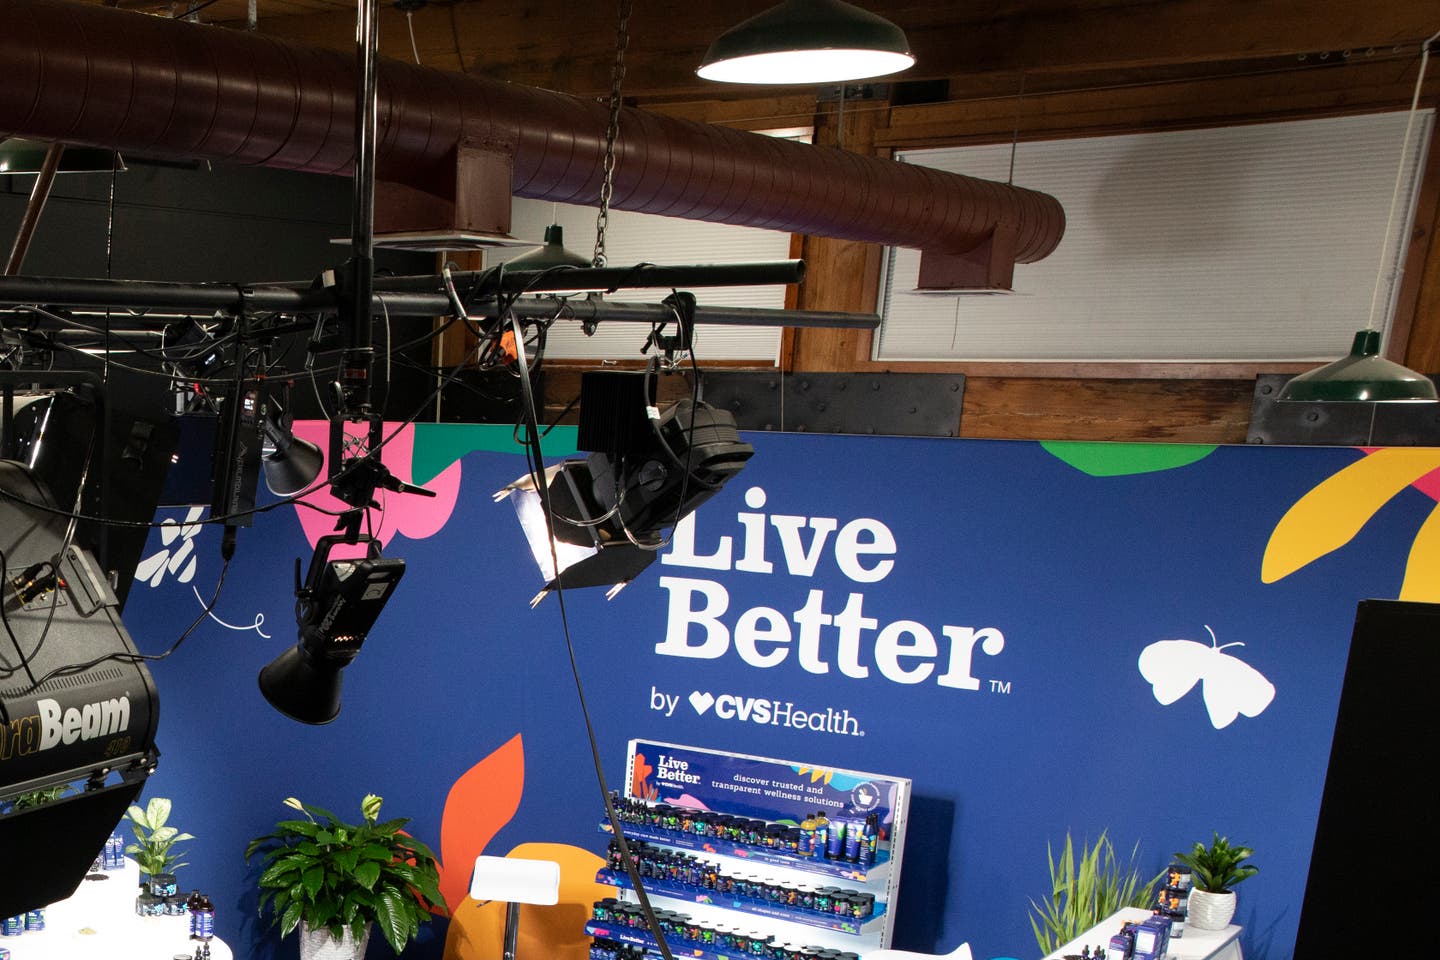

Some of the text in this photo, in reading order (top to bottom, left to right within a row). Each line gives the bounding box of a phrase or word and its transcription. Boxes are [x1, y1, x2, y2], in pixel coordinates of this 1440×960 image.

[661, 486, 897, 583] Live
[655, 575, 1006, 691] Better
[649, 685, 680, 717] by
[656, 766, 700, 785] Better
[658, 754, 689, 770] Live
[711, 780, 762, 796] transparent
[763, 788, 802, 802] wellness
[803, 794, 845, 809] solutions
[733, 773, 823, 796] discover trusted and
